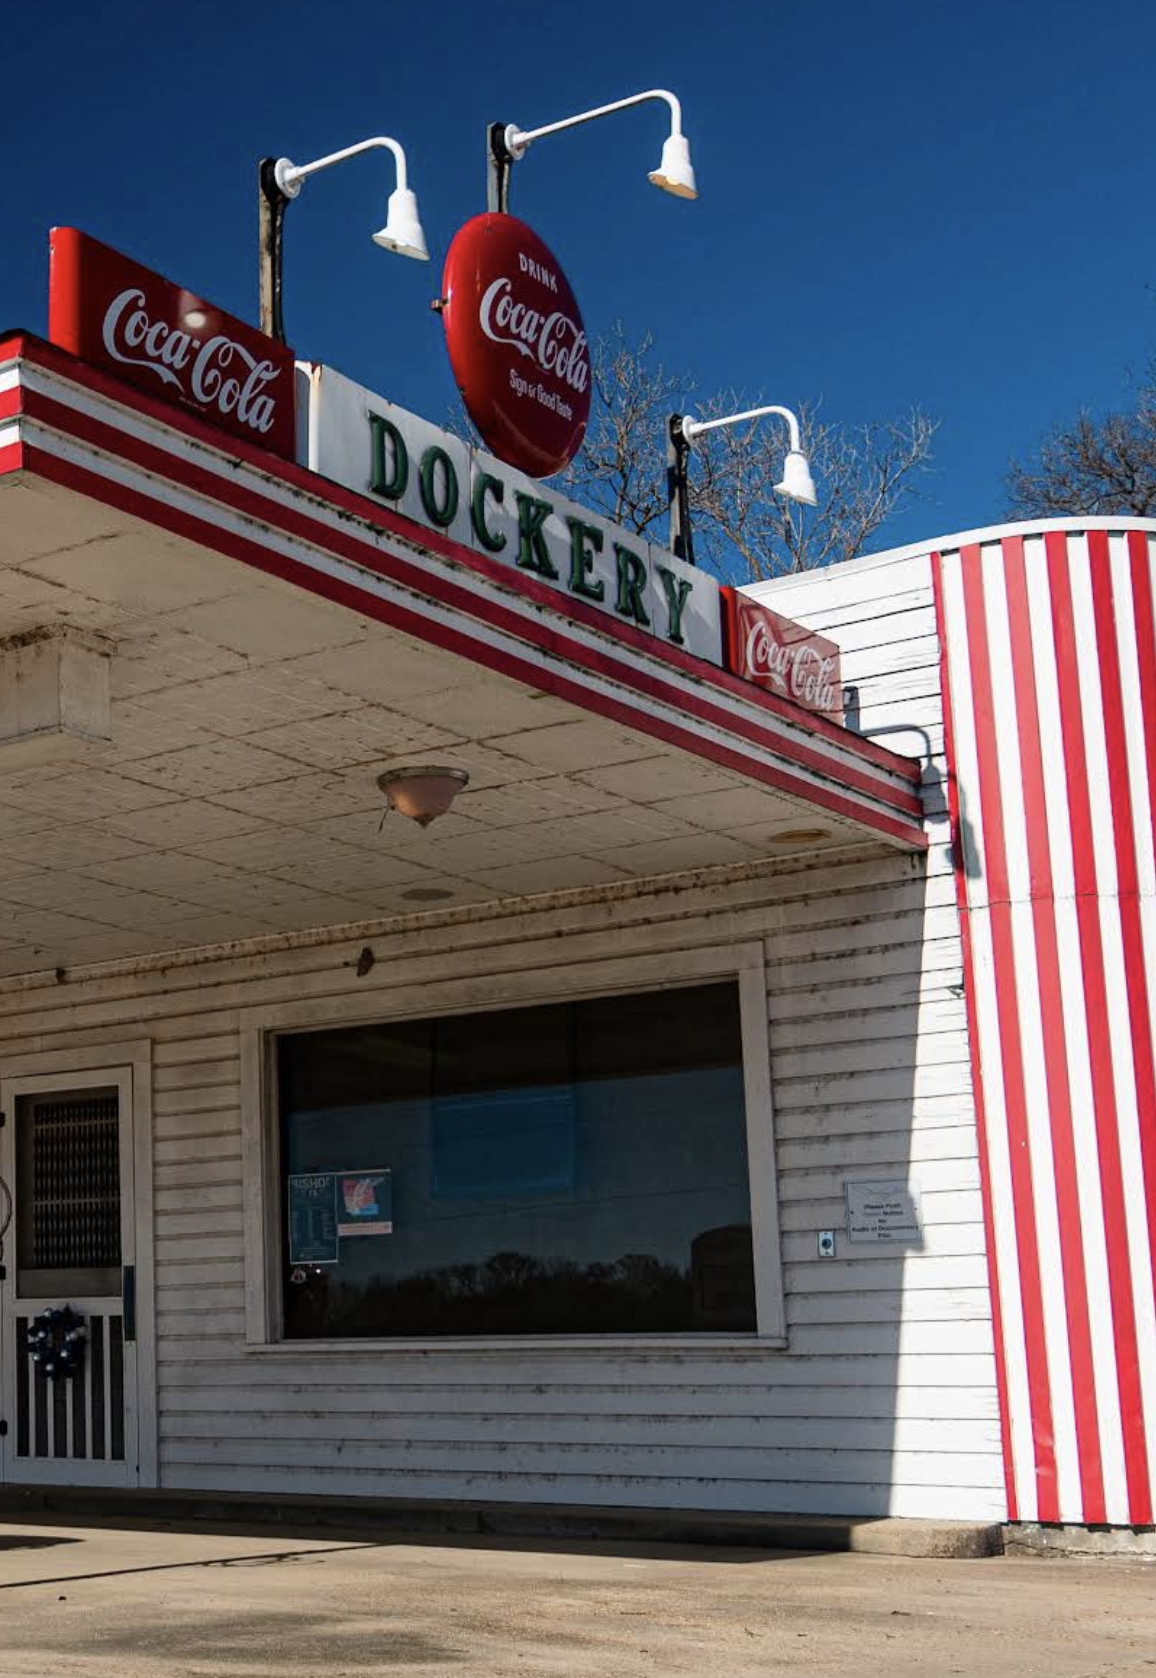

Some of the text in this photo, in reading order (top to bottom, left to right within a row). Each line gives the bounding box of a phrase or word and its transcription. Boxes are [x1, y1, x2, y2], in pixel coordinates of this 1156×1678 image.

[479, 277, 588, 393] Coca-Cola
[518, 252, 558, 294] DRINK
[102, 288, 282, 433] Coca-Cola
[367, 409, 693, 644] DOCKERY
